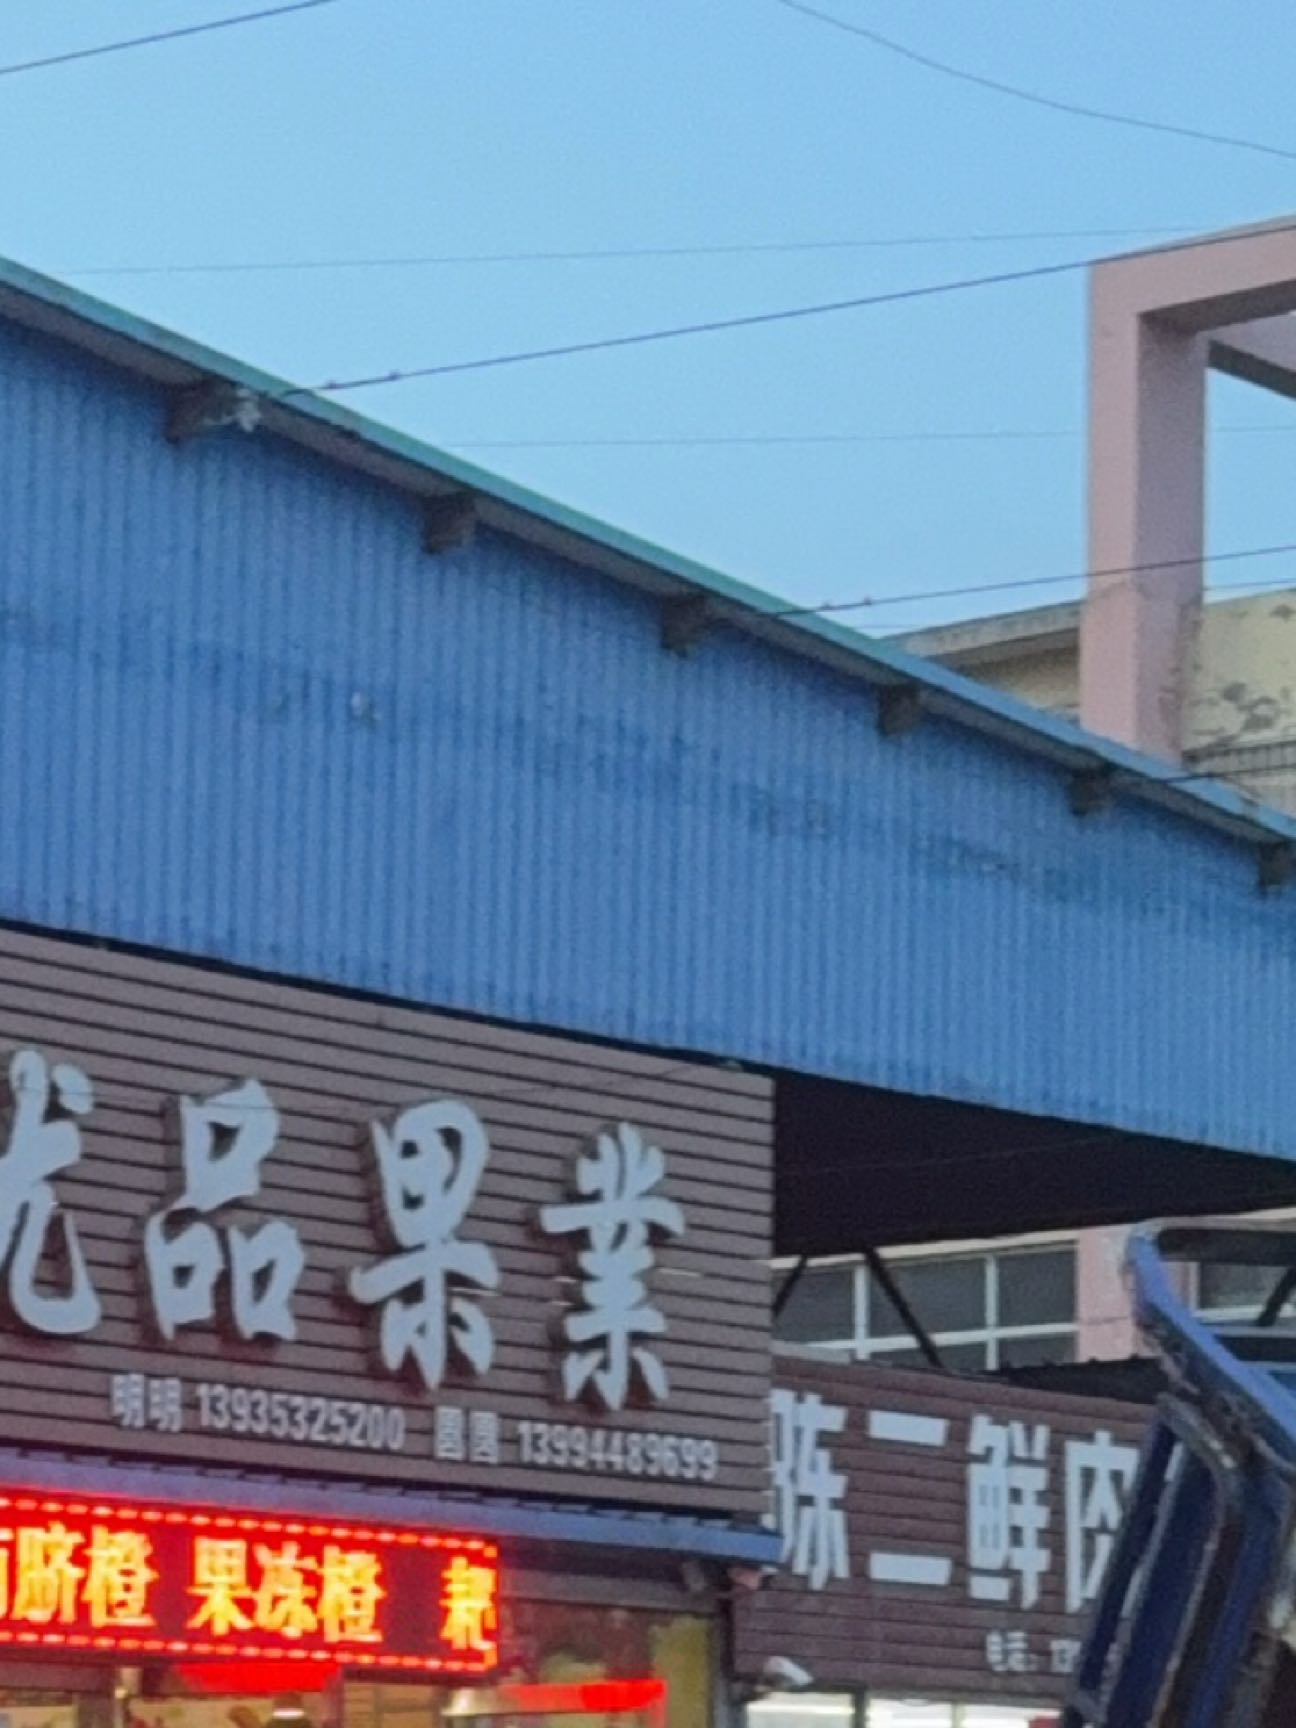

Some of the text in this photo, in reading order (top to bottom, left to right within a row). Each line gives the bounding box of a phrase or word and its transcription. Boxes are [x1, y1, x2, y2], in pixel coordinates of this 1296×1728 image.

[196, 1383, 406, 1451] 13935325200
[517, 1420, 720, 1482] 13994489699
[186, 1535, 386, 1643] 果冻橙
